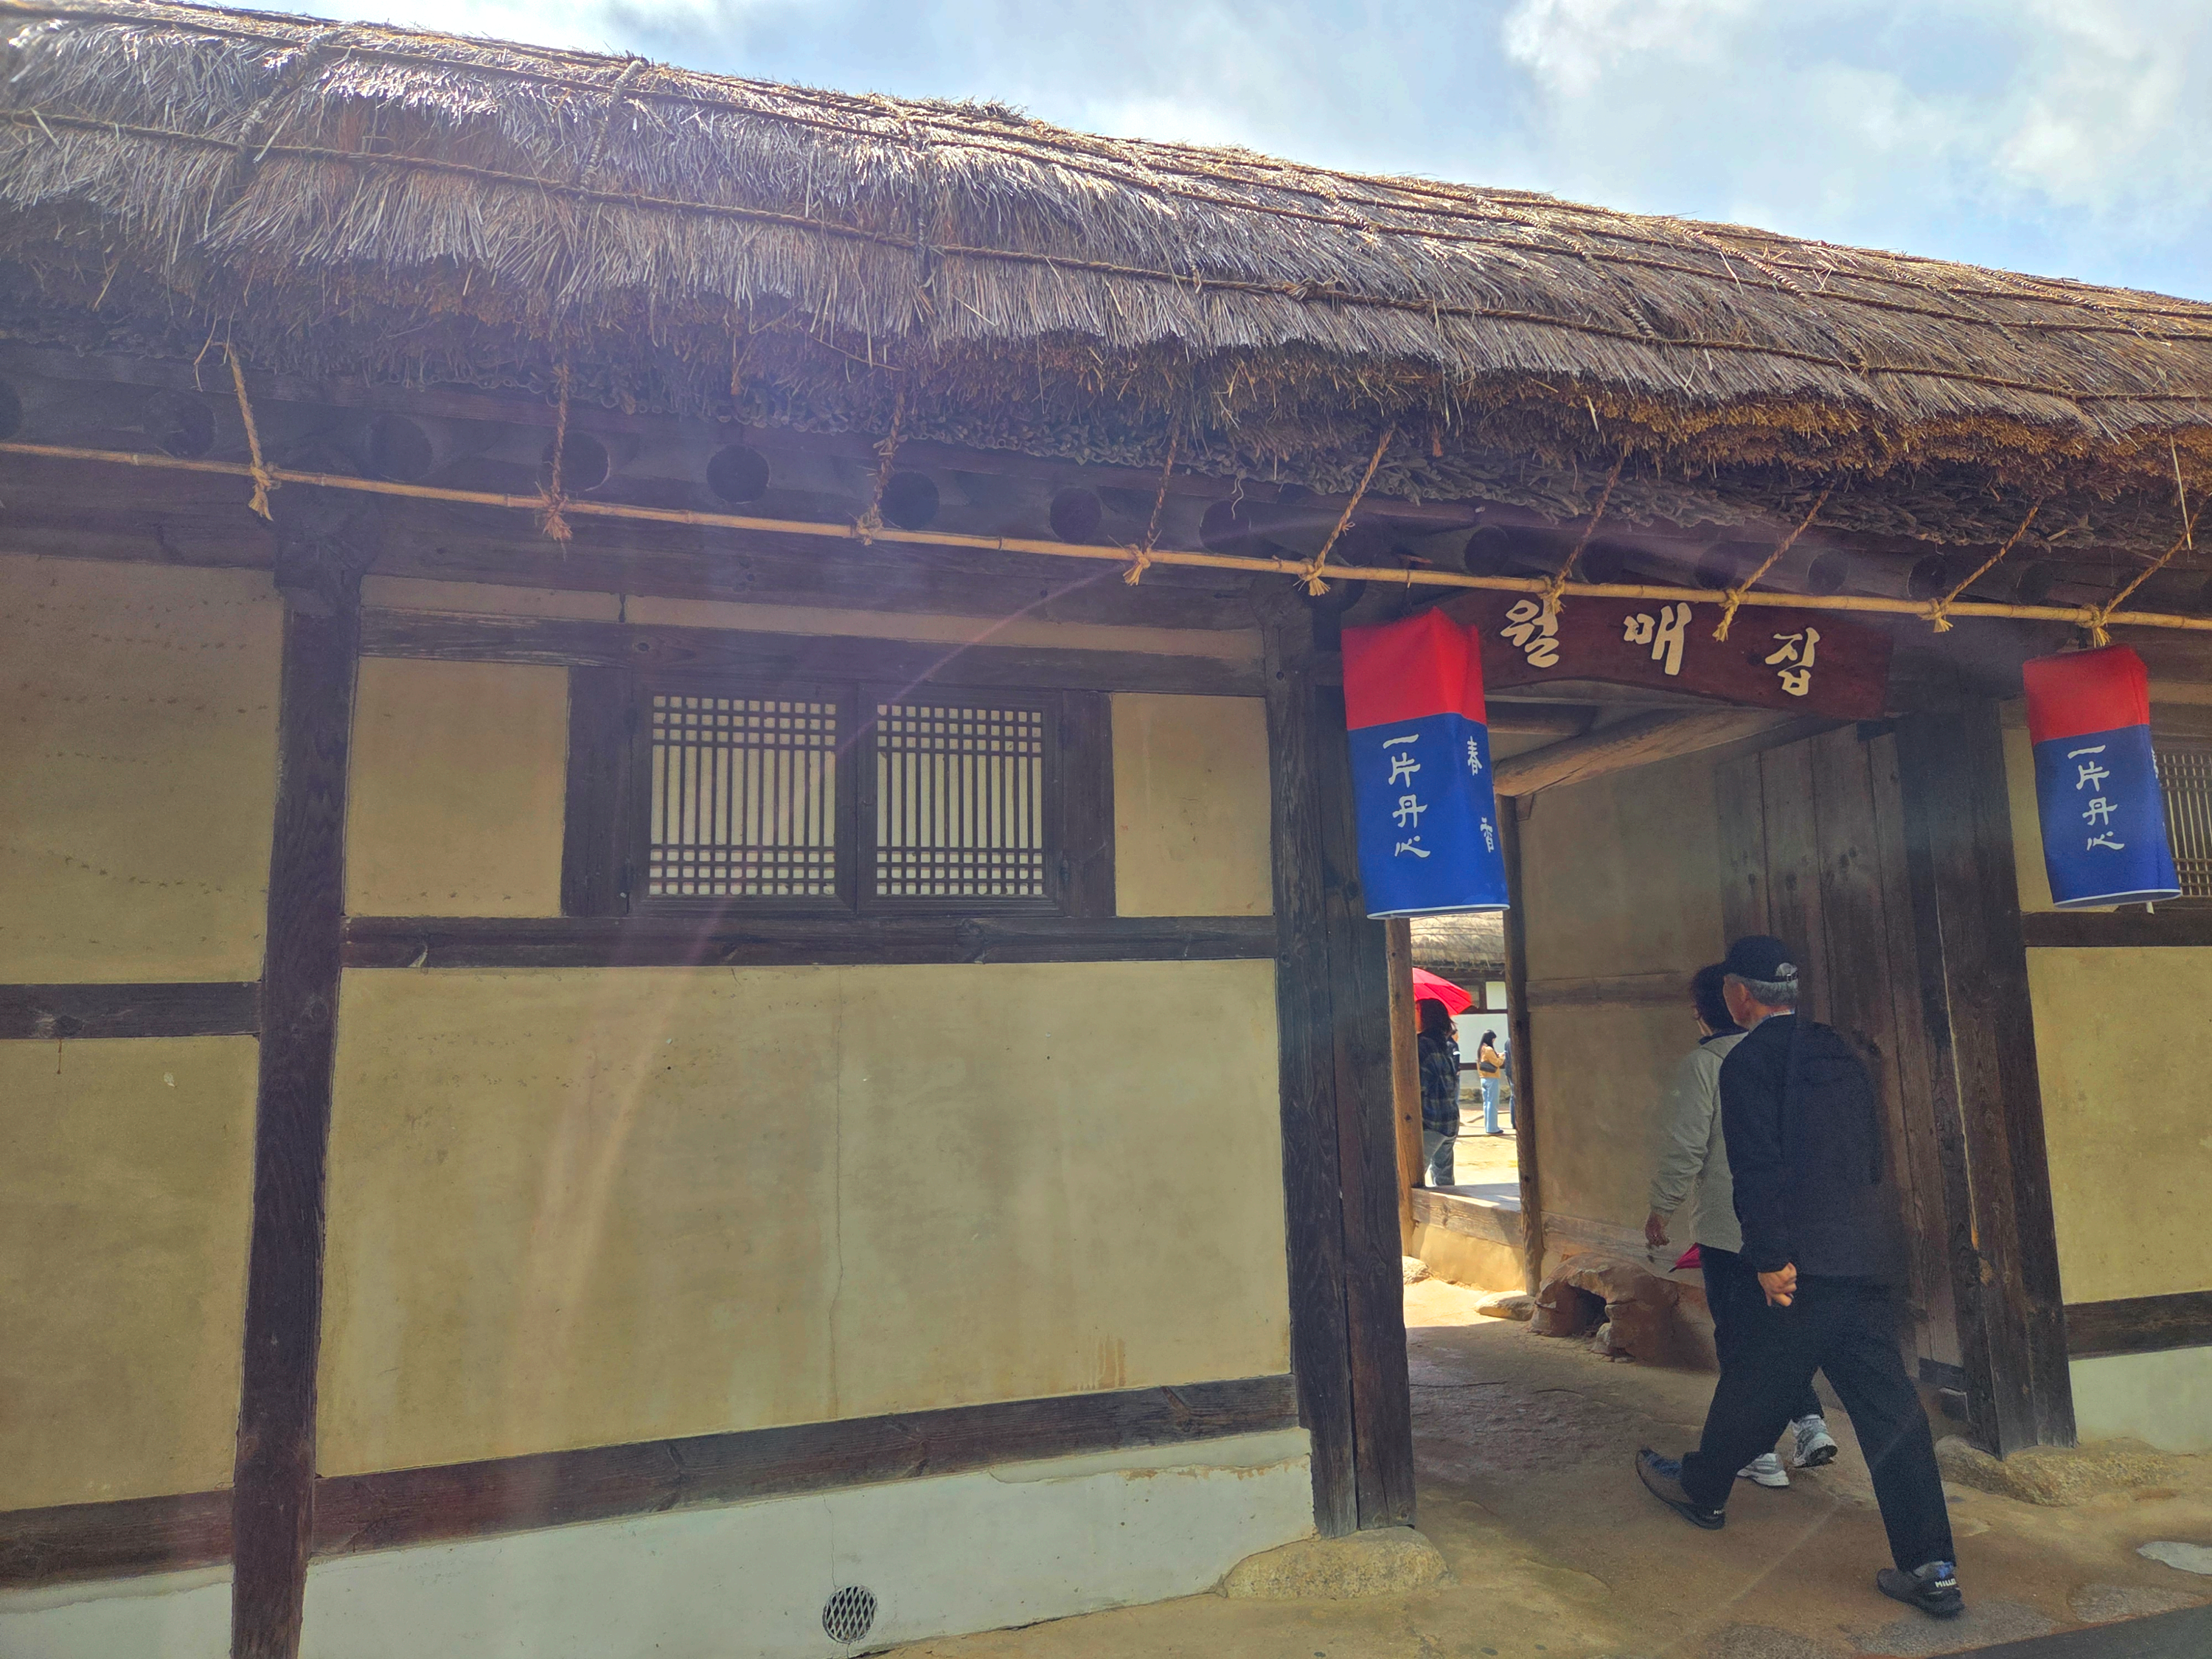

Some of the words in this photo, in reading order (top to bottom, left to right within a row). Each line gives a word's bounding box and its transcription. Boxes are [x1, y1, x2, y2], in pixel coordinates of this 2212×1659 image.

[1500, 599, 1820, 696] 월매집
[1383, 734, 1430, 858] 一片丹心
[2067, 745, 2124, 850] 一片丹心
